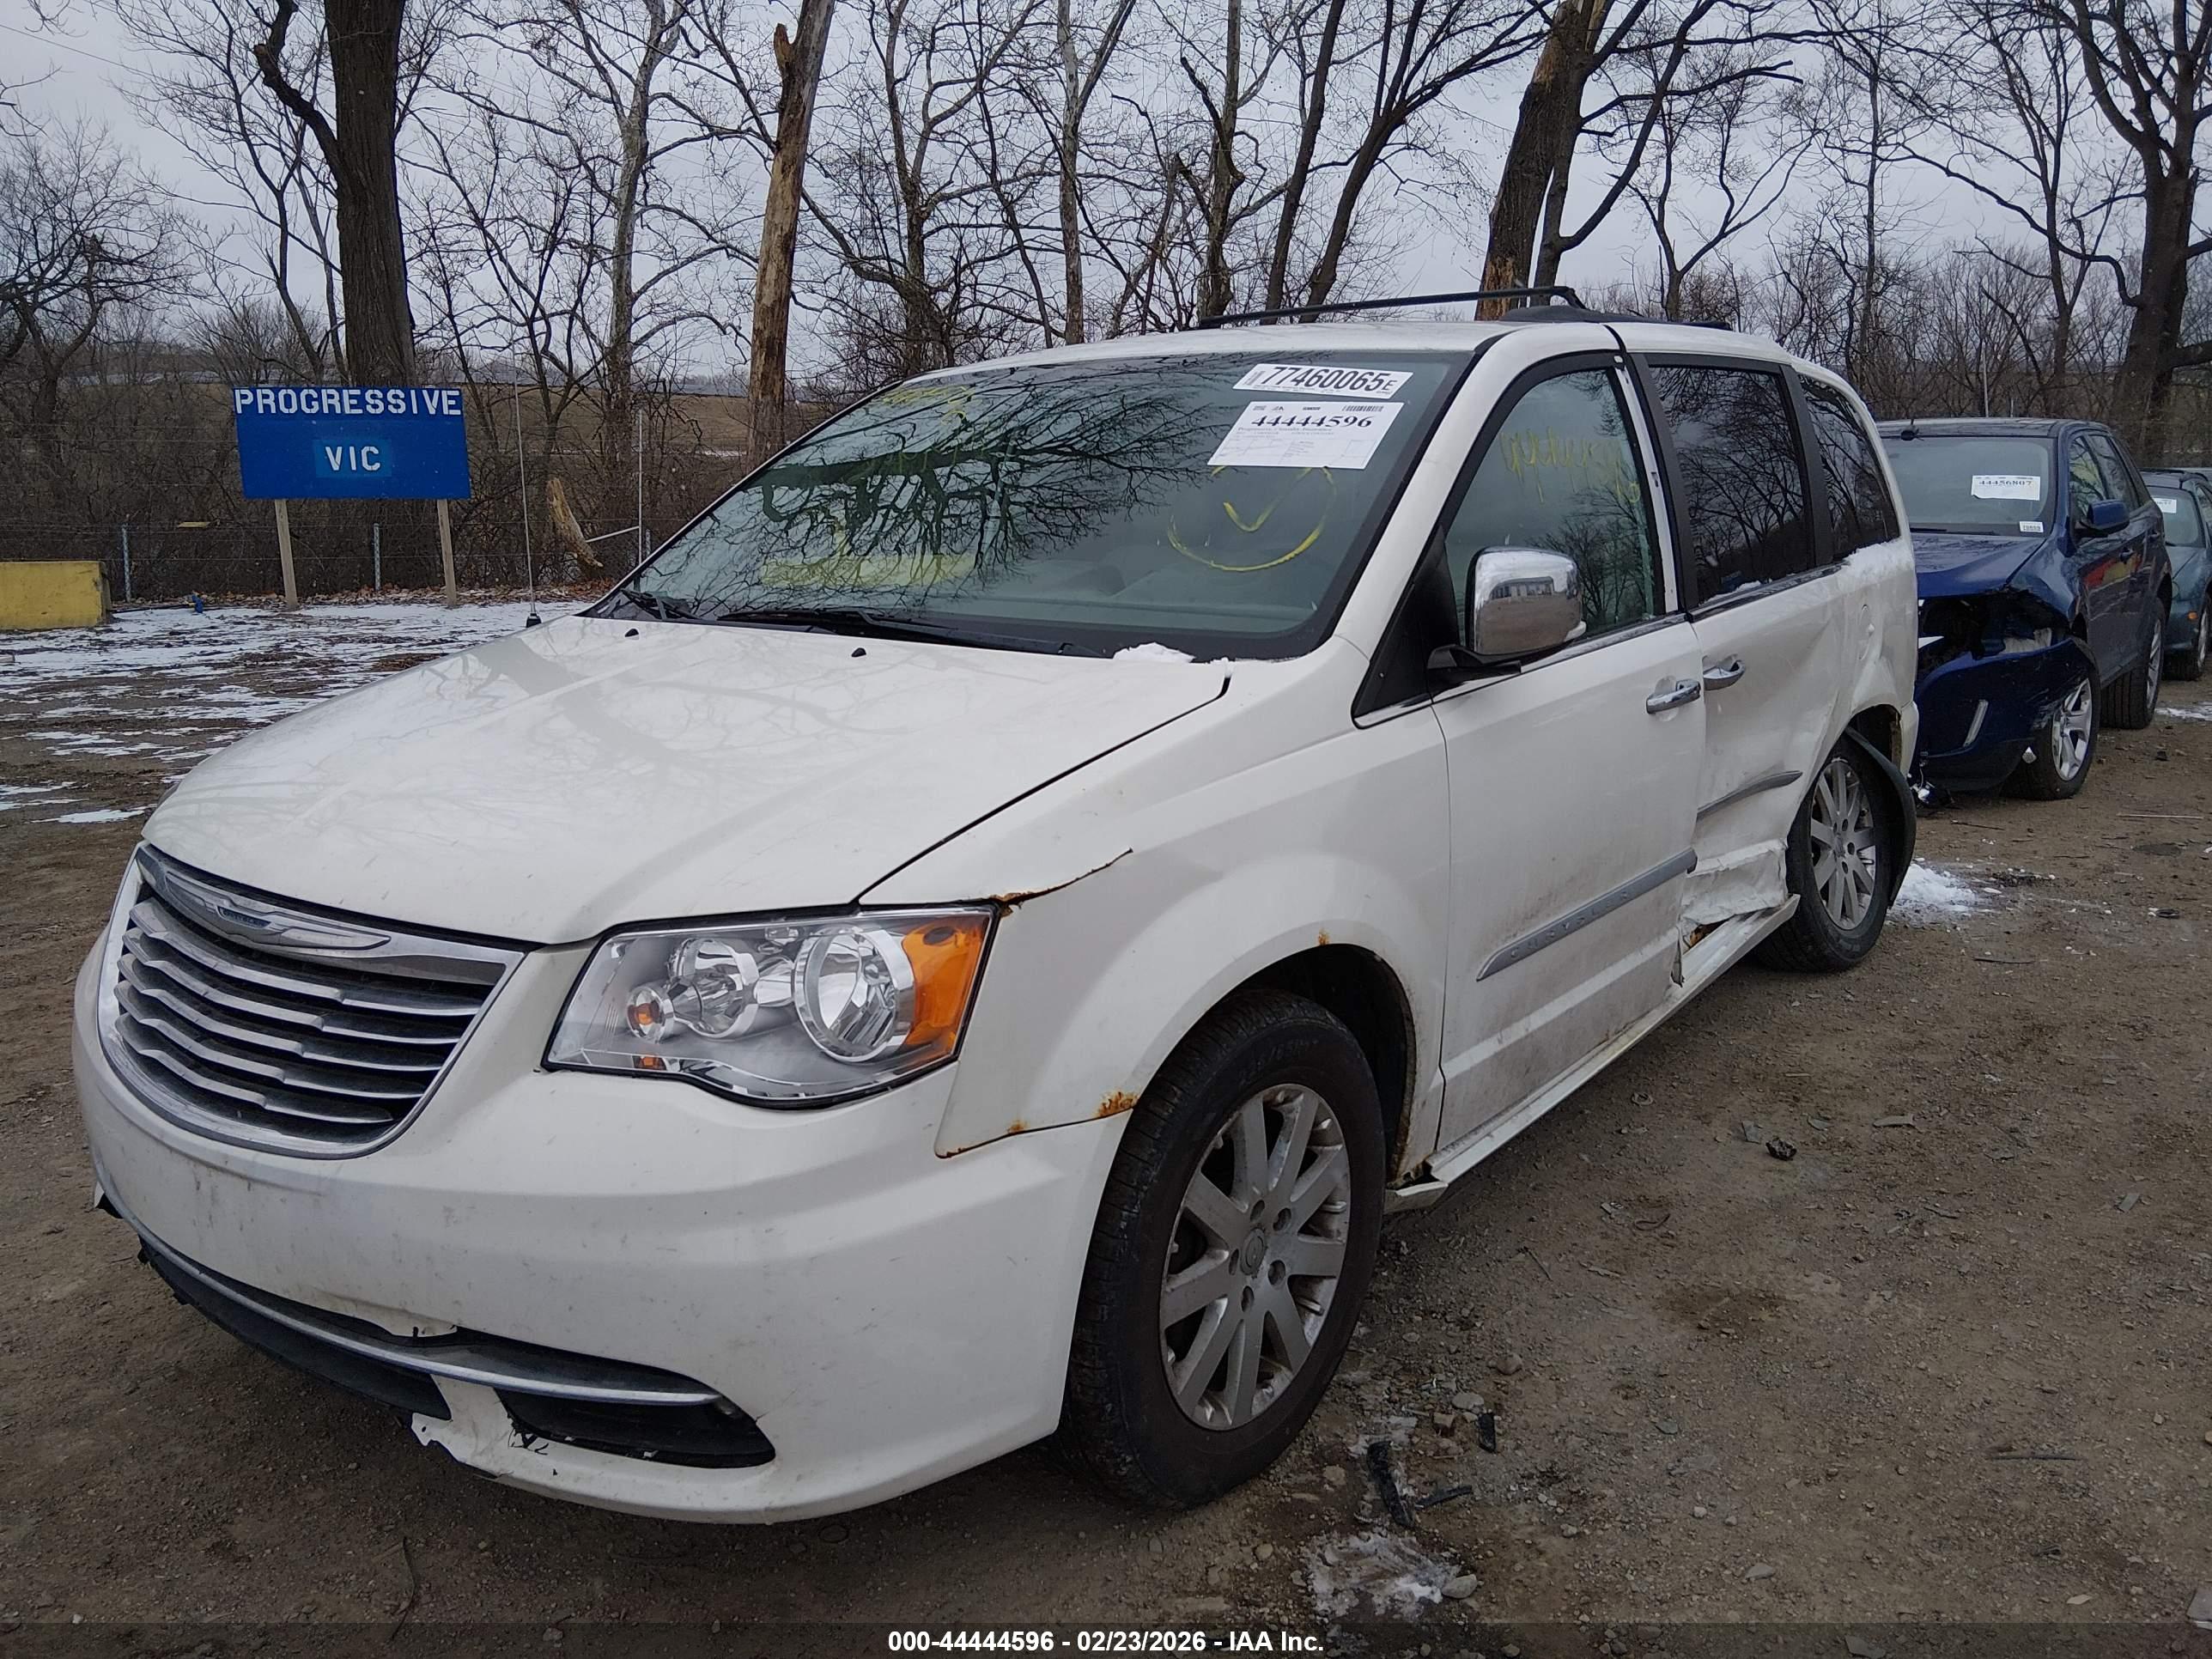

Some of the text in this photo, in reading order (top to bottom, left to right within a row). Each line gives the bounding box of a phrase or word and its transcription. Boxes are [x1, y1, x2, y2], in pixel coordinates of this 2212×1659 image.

[234, 388, 461, 416] PROGRESSIVE
[1251, 415, 1375, 428] 44444596
[325, 446, 380, 471] VIC
